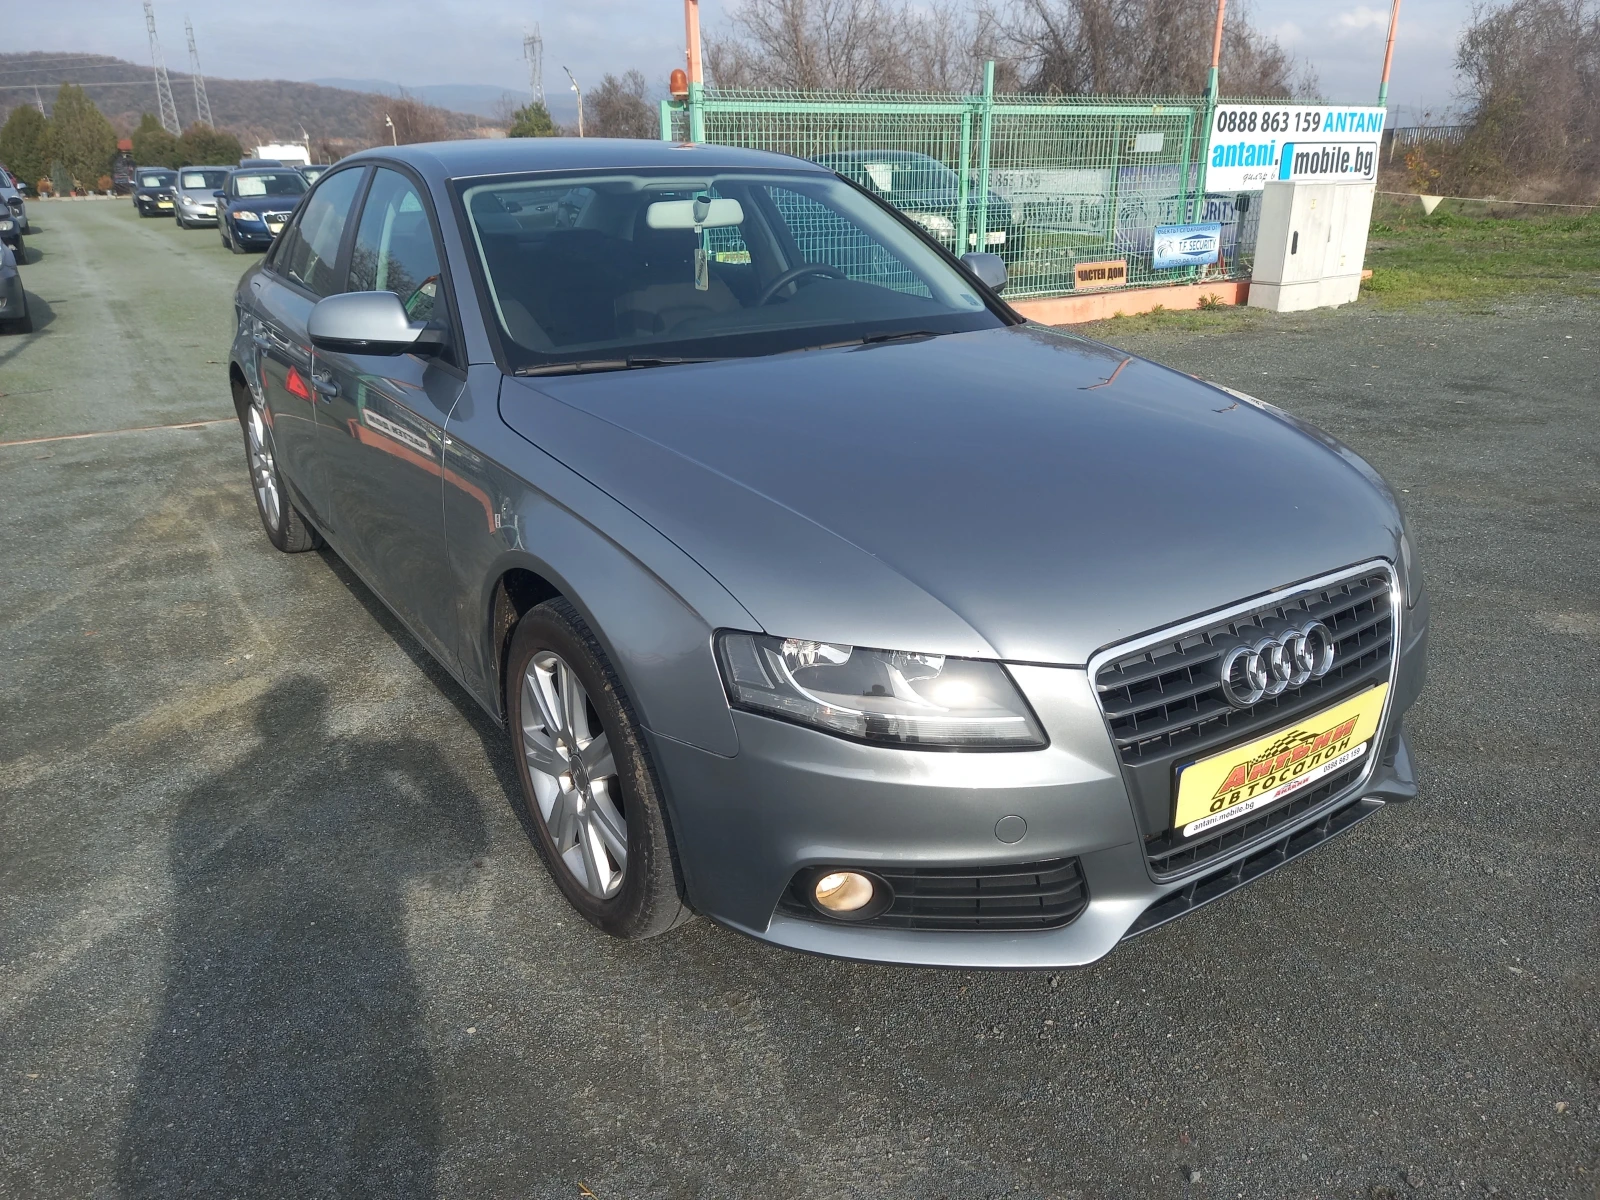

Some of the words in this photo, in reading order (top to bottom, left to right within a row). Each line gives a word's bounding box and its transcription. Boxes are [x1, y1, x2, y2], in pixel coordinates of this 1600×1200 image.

[1217, 111, 1258, 133] 0888
[1260, 111, 1290, 133] 863
[1294, 112, 1321, 133] 159
[1322, 112, 1384, 133] ANTANI
[1188, 239, 1217, 251] SECURITY
[1078, 268, 1106, 282] ЧАСТЕН
[1107, 267, 1124, 281] ДОМ
[1193, 801, 1255, 831] antani.mobile.bg
